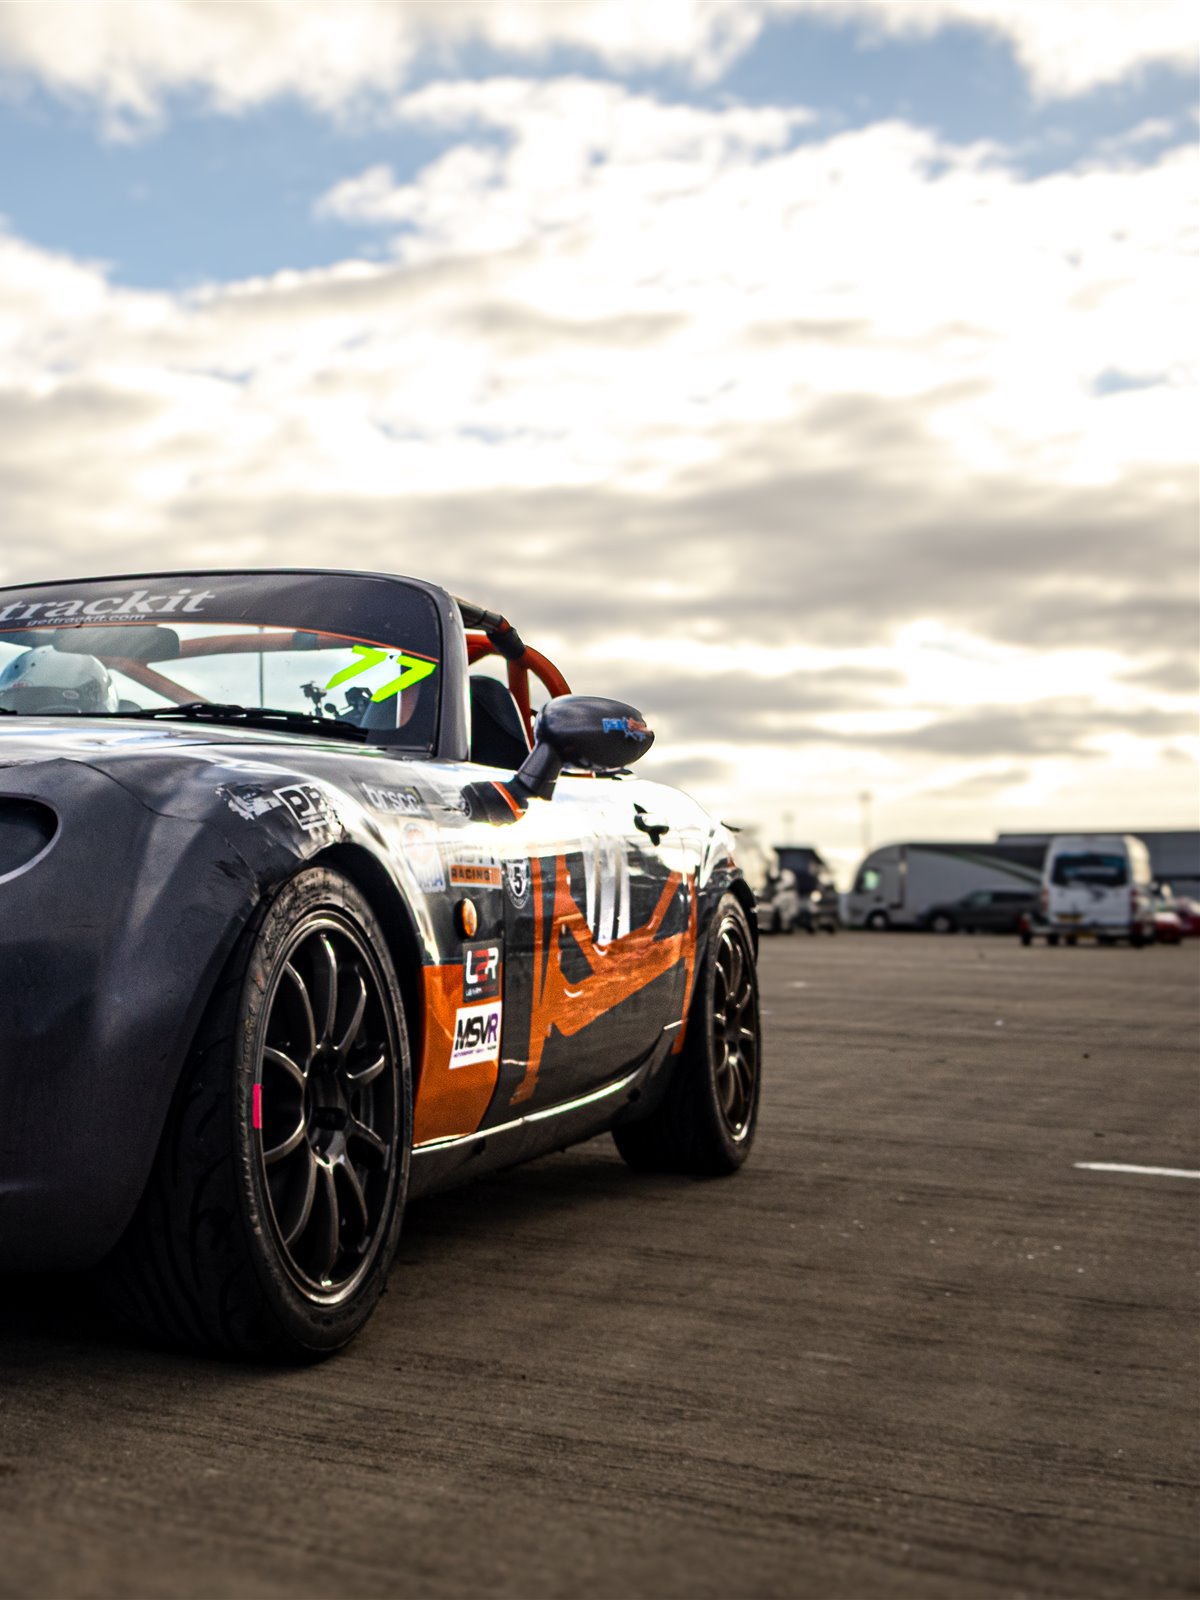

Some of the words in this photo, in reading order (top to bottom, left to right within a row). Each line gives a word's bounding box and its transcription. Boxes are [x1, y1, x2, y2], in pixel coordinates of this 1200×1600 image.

[27, 613, 147, 627] gettrackit.com
[451, 866, 491, 882] RACING
[455, 1013, 498, 1051] MSVR
